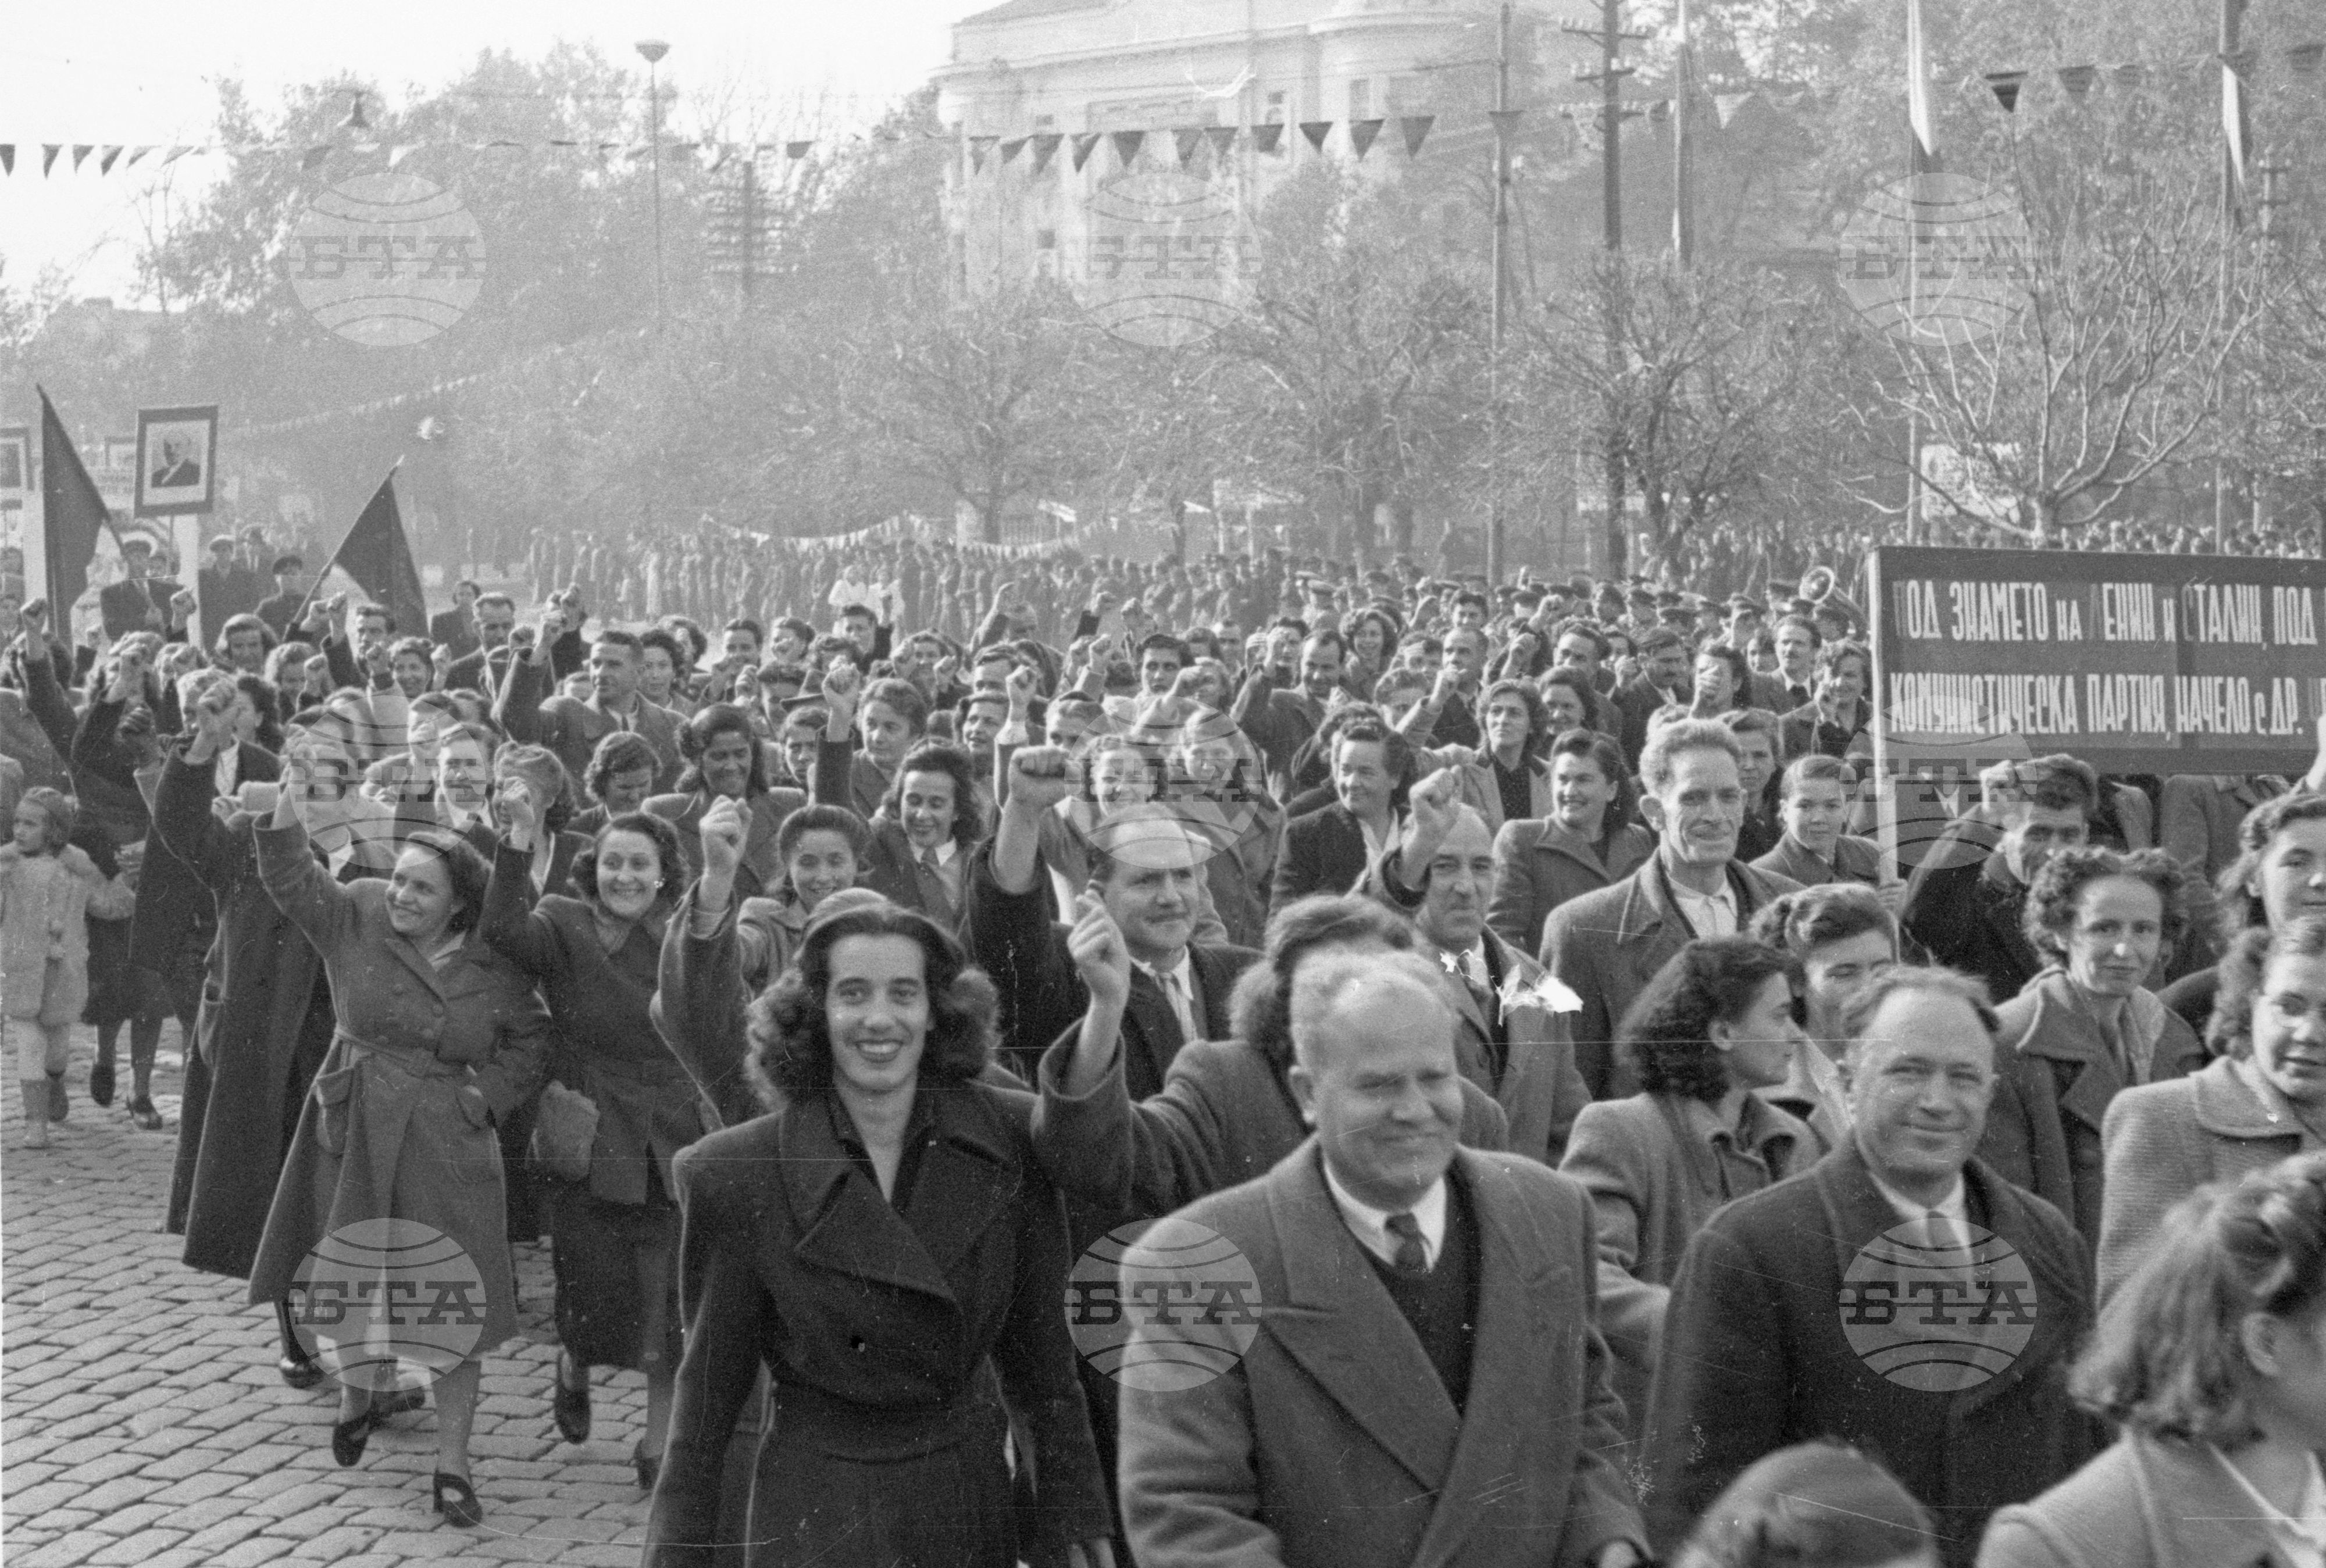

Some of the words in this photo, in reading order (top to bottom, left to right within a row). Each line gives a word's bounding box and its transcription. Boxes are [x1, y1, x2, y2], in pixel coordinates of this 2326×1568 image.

[1892, 580, 1942, 639] ПОД
[1950, 581, 2049, 641] ЗНАМЕТО
[2273, 585, 2318, 645] ПОД
[1890, 672, 2079, 734] КОМУНИСТИЧЕСКА
[2175, 676, 2251, 734] НАЧЕЛО
[2270, 677, 2303, 735] ДР.
